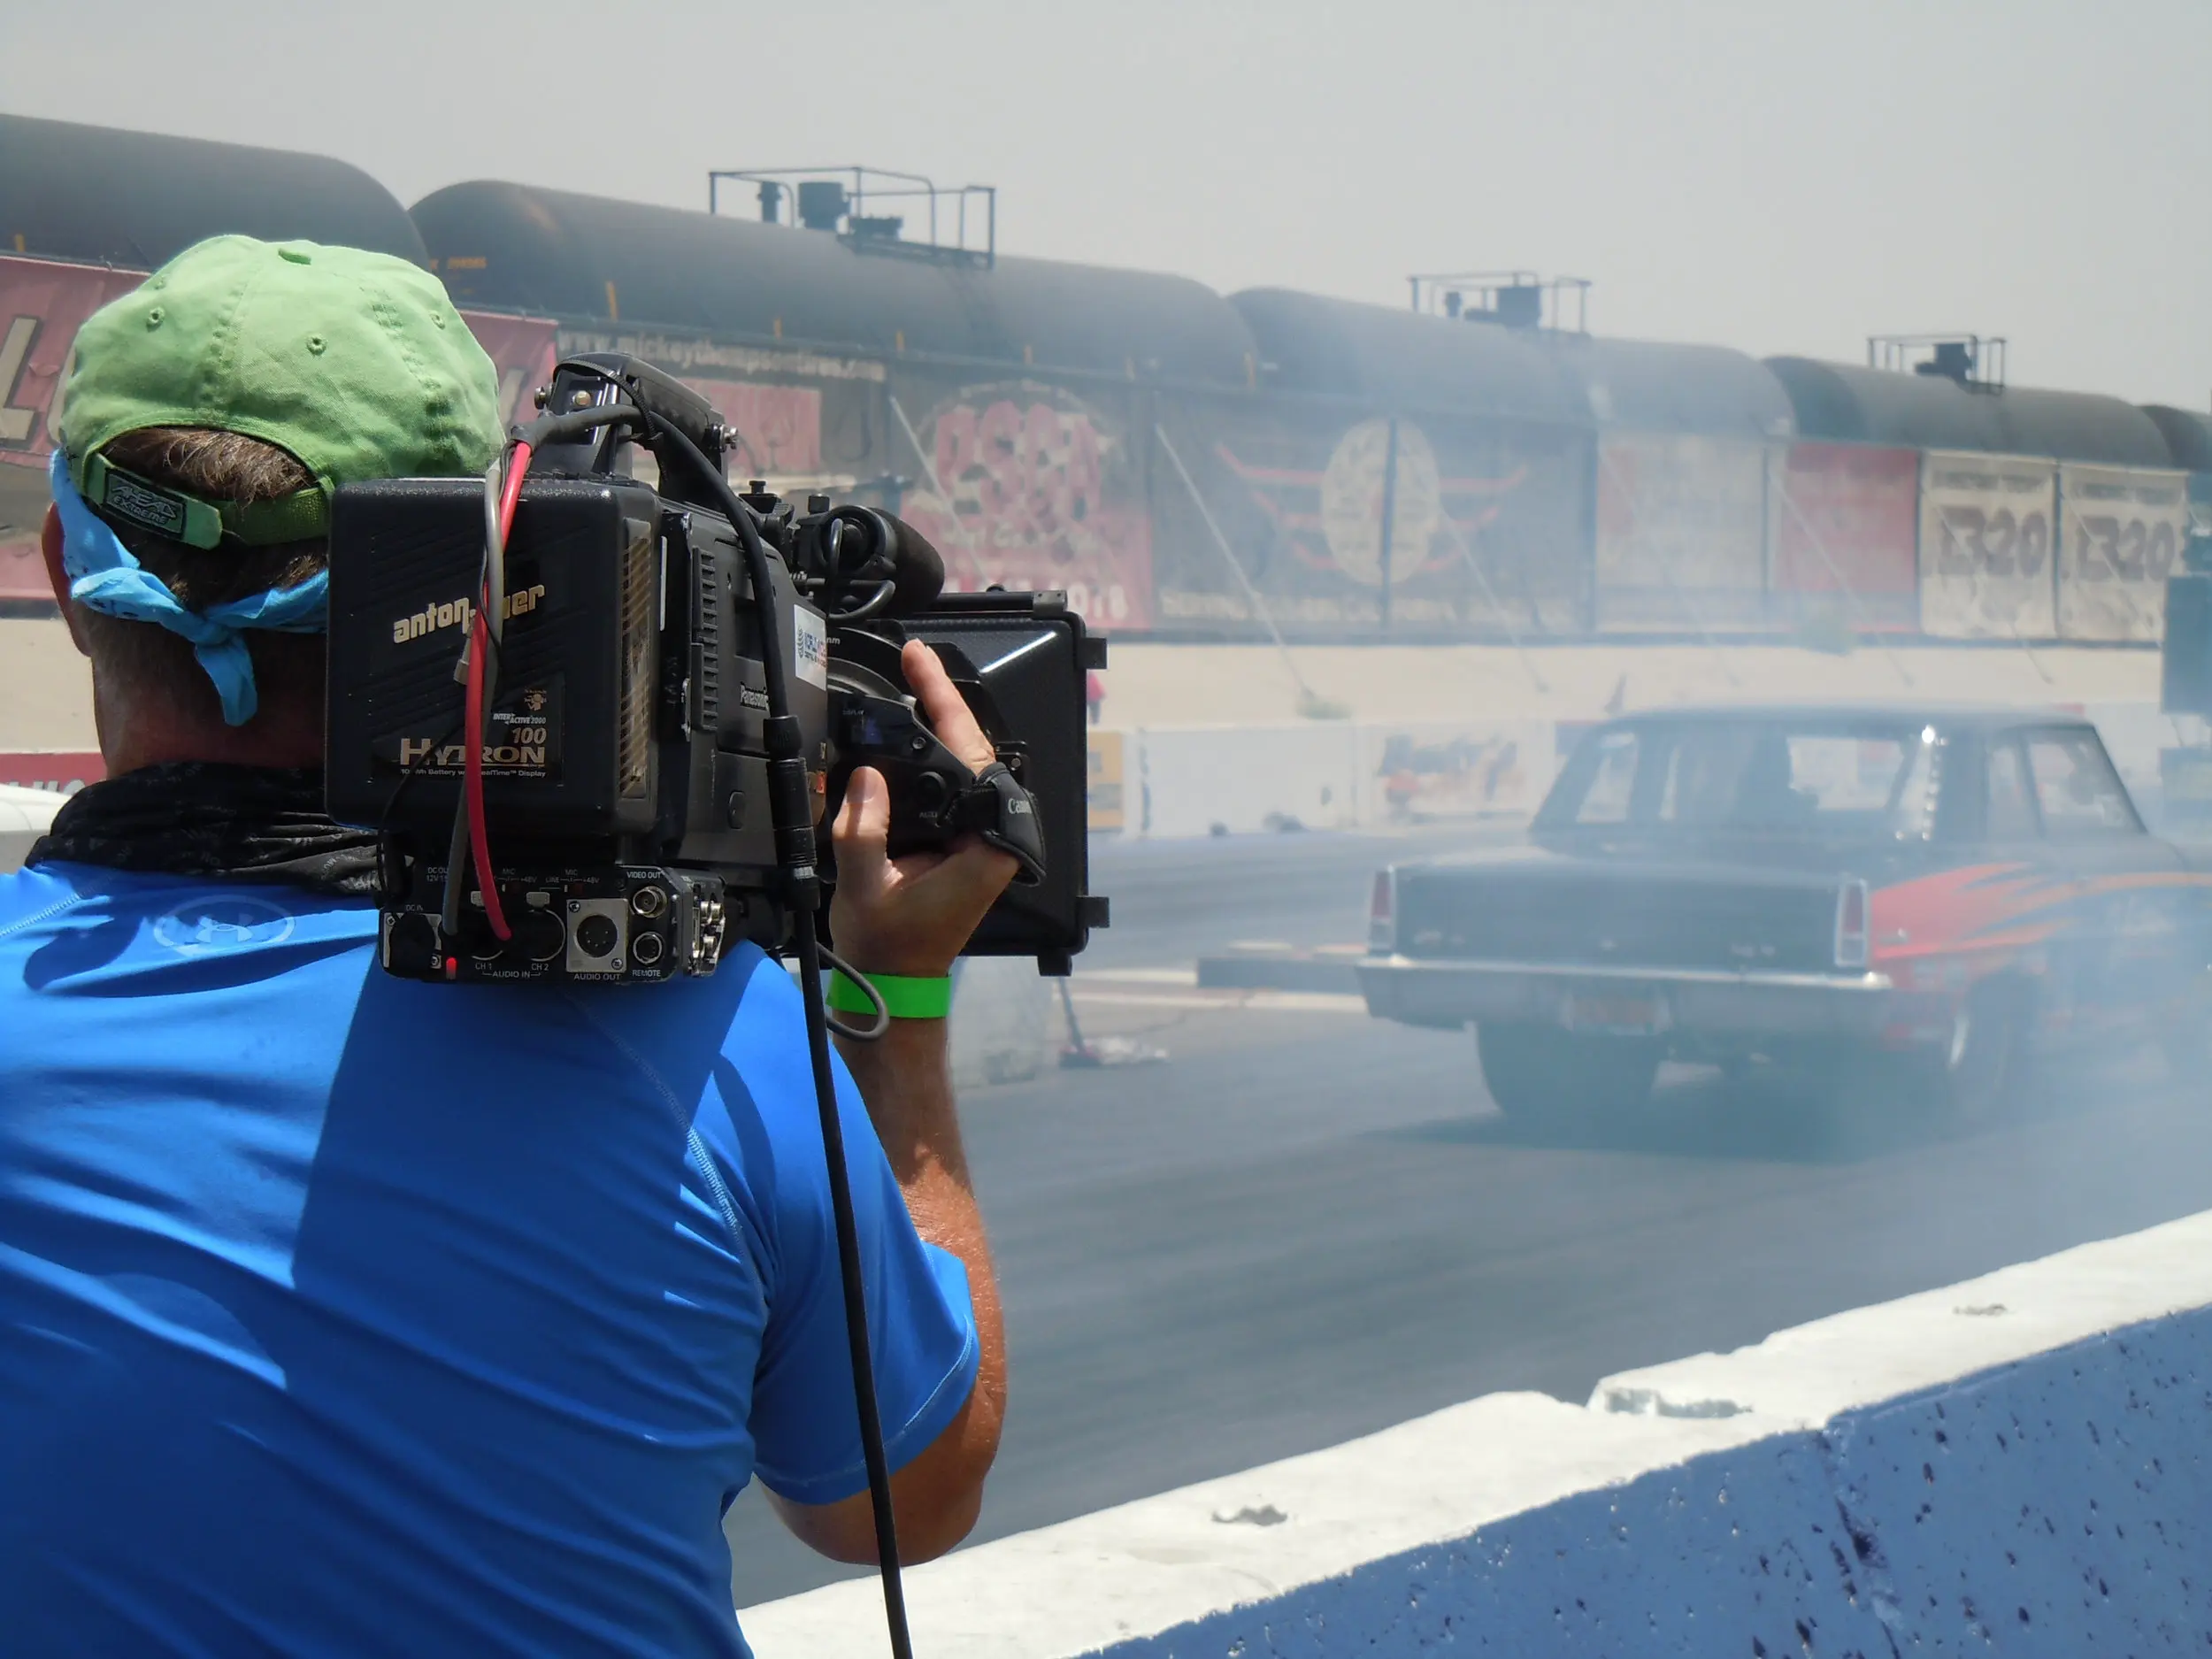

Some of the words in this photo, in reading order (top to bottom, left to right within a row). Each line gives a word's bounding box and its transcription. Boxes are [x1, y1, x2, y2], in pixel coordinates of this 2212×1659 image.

[112, 495, 169, 526] EXTREME
[511, 727, 547, 745] 100
[428, 769, 456, 778] Battery
[518, 770, 546, 779] Display
[626, 871, 646, 879] VIDEO
[647, 872, 662, 880] OUT
[632, 969, 662, 978] REMOTE
